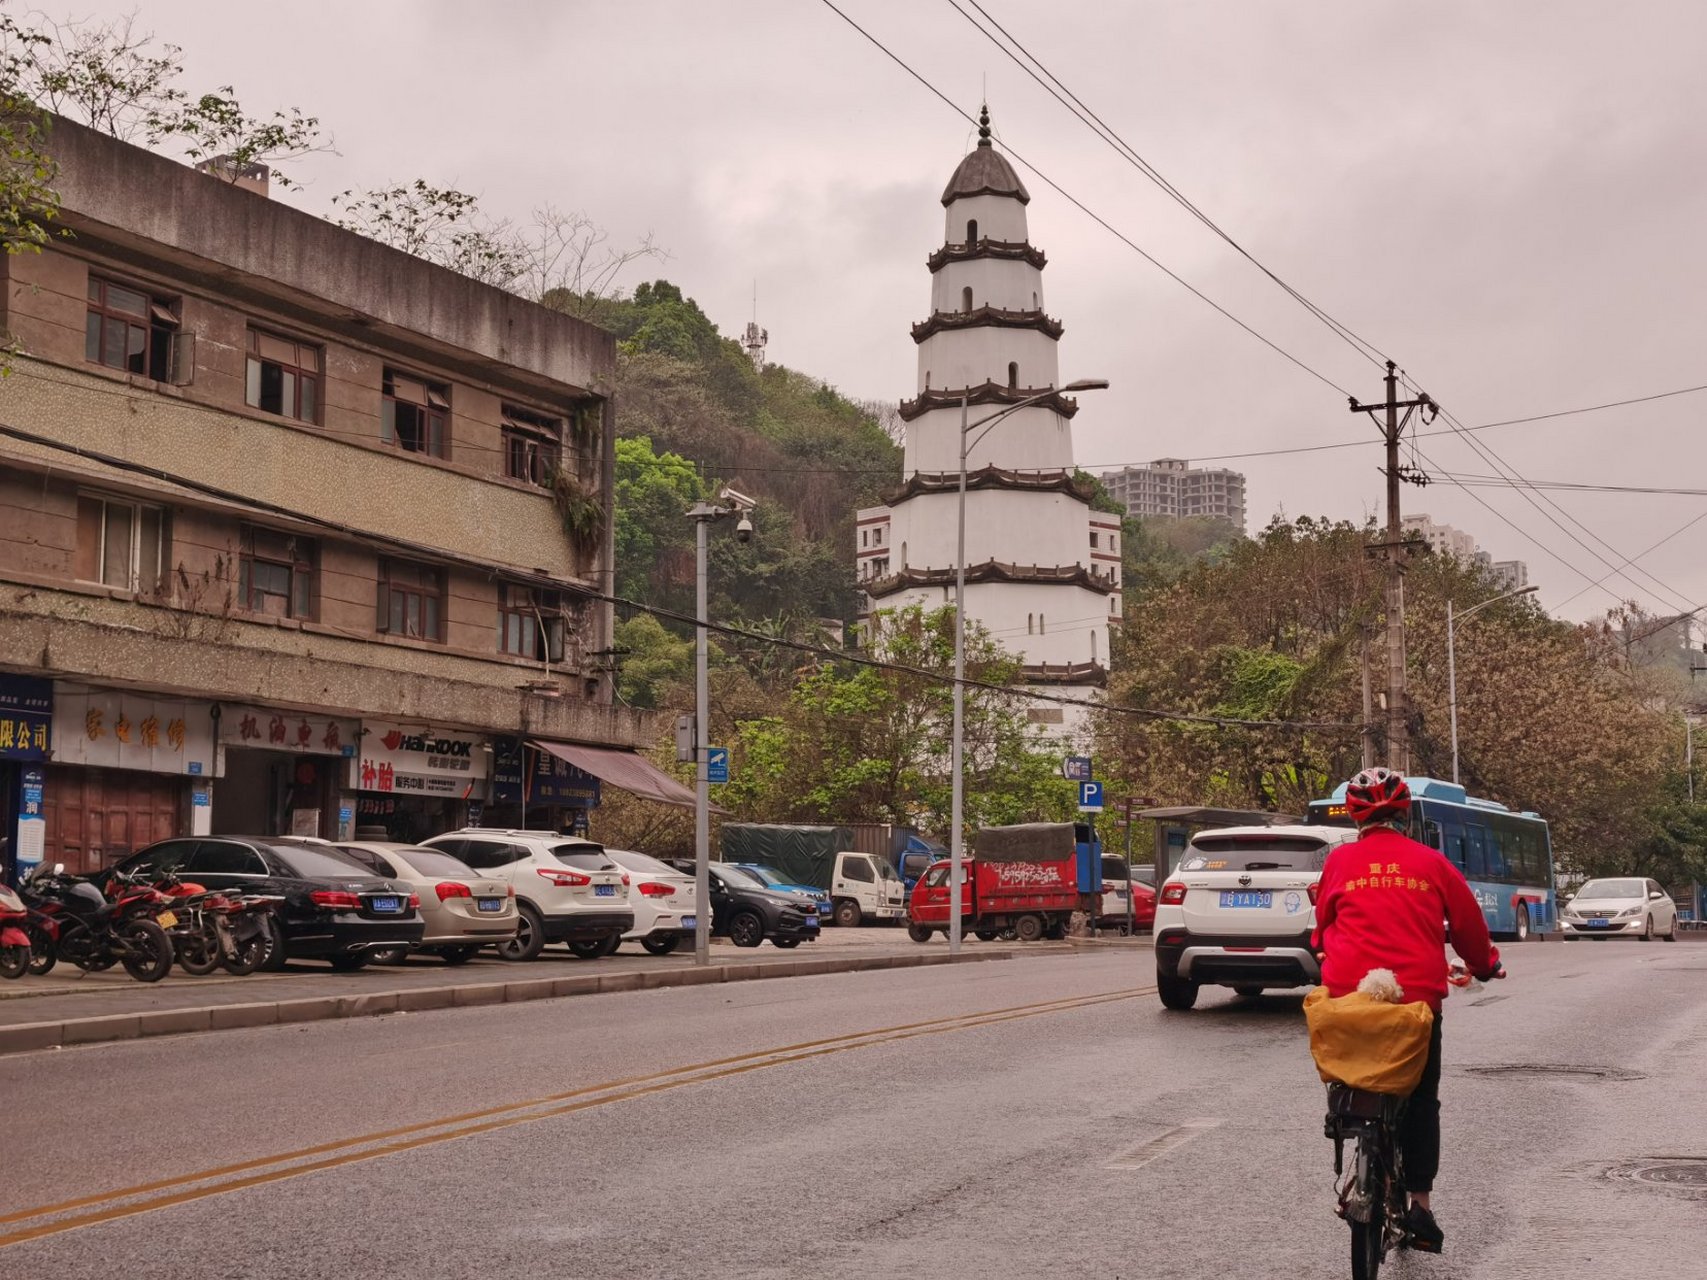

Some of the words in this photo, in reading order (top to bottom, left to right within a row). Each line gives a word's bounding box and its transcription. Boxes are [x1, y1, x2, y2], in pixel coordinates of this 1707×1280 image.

[239, 713, 342, 751] 机油电瓶
[362, 758, 394, 791] 补胎
[1083, 783, 1098, 804] P
[1369, 863, 1401, 874] 重庆
